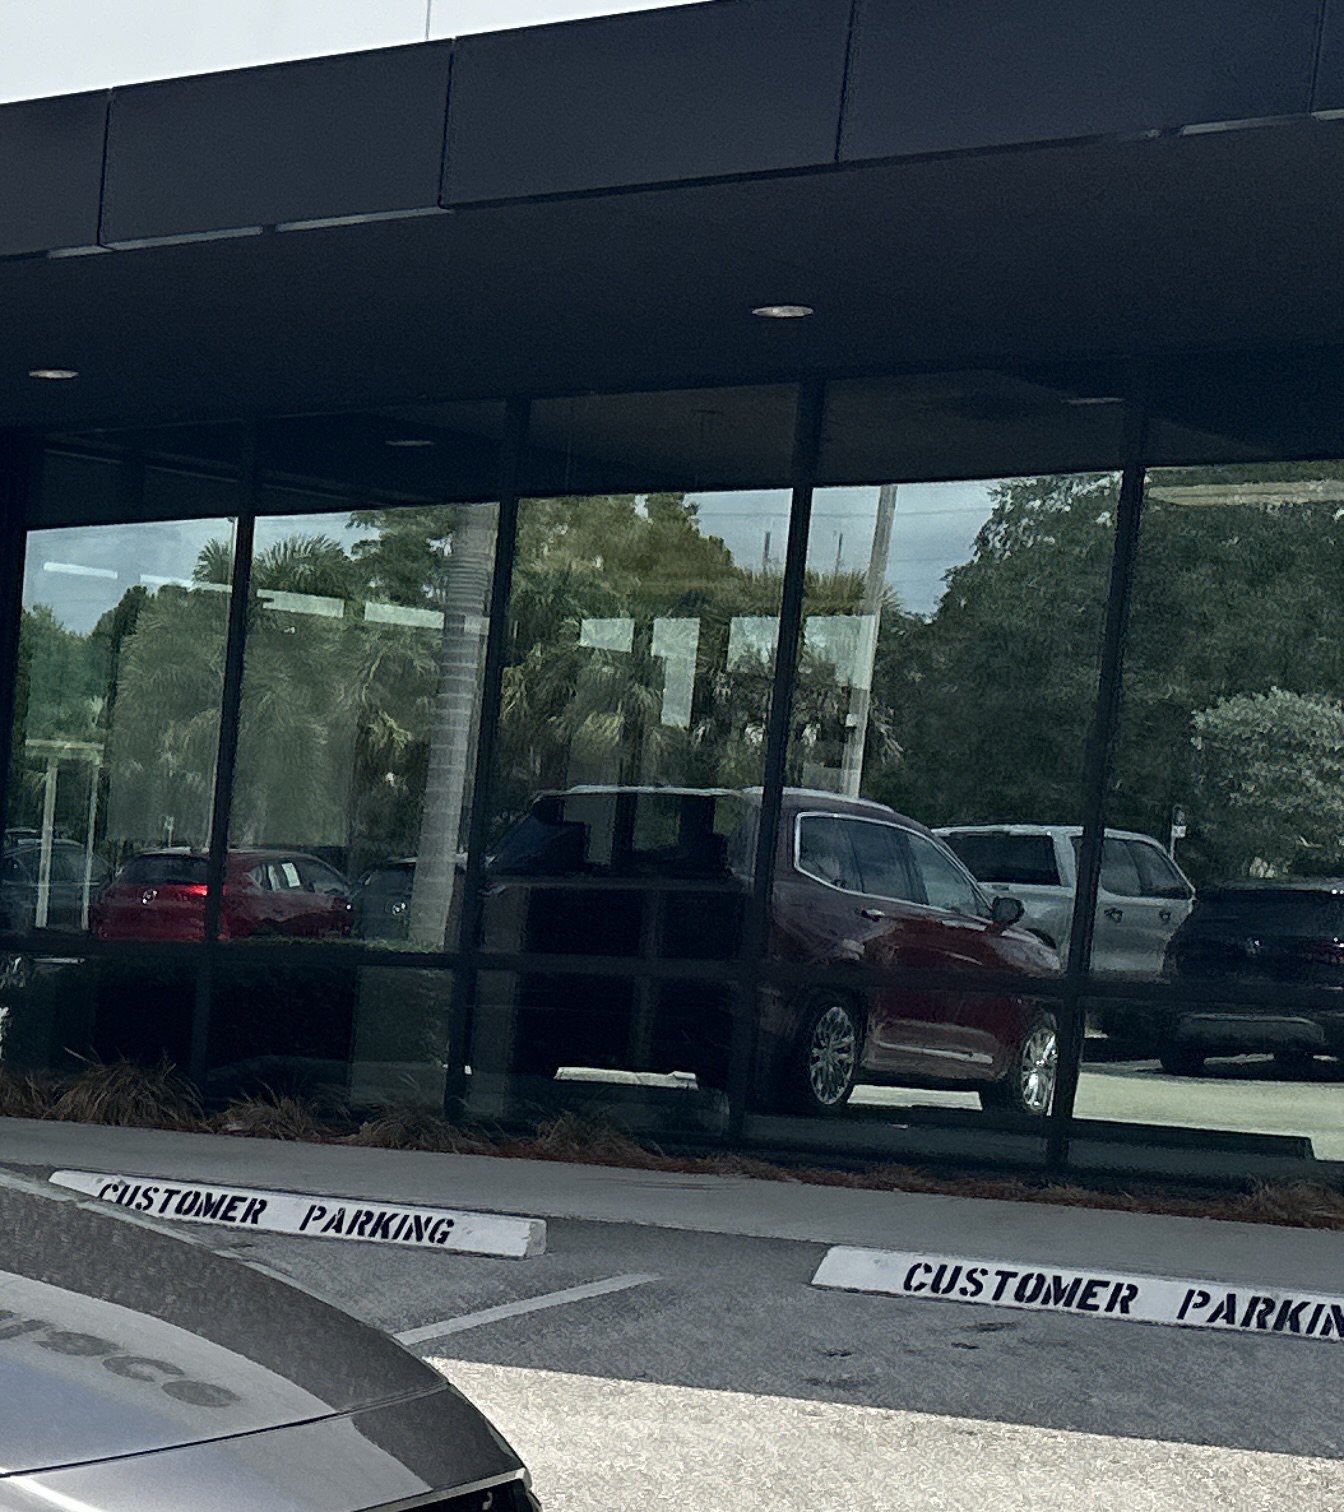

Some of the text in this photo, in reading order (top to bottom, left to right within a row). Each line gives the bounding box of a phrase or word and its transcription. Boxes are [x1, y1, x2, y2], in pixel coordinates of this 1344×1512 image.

[97, 1183, 455, 1245] CUSTOMER PARKING
[903, 1262, 1139, 1315] CUSTOMER
